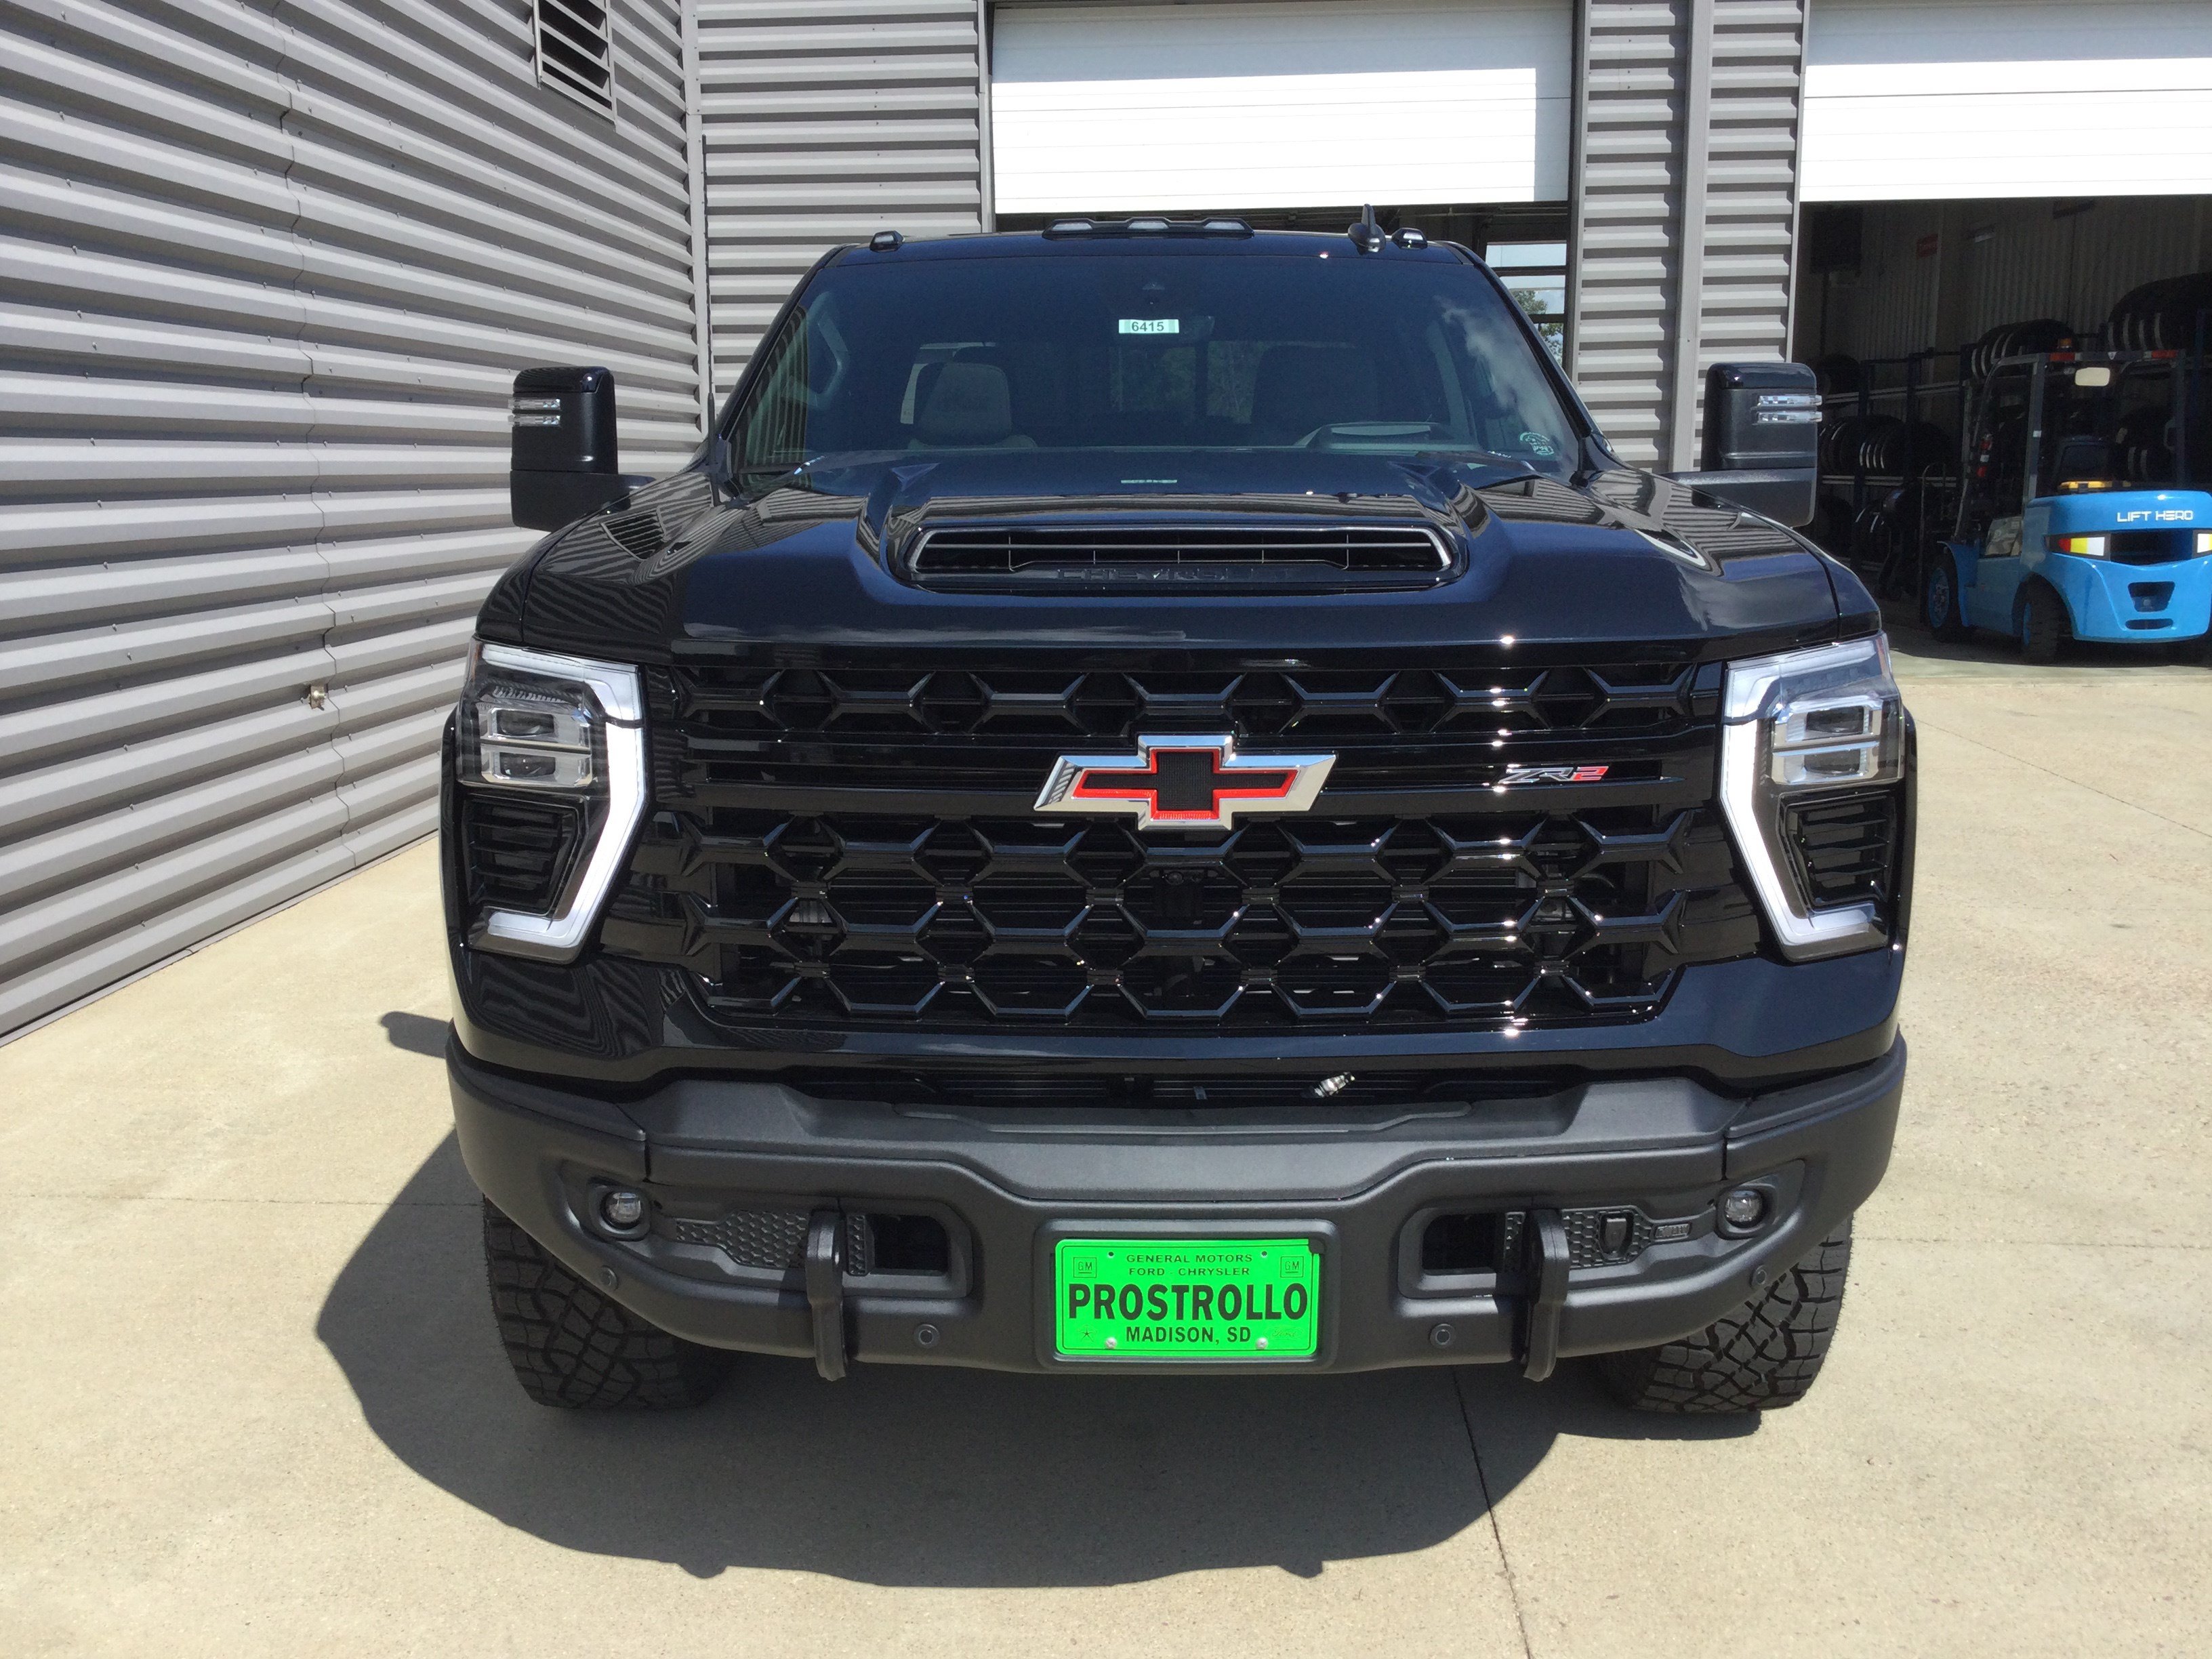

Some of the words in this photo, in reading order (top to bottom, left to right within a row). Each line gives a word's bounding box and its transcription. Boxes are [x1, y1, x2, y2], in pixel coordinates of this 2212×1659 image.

[1131, 321, 1164, 332] 6415
[2116, 511, 2152, 523] LIFT
[2155, 510, 2193, 521] HERO
[1498, 766, 1609, 784] ZR2
[1126, 1254, 1190, 1263] GENERAL
[1195, 1254, 1252, 1263] MOTORS
[1078, 1261, 1093, 1271] GM
[1129, 1268, 1165, 1276] FORD
[1178, 1267, 1250, 1276] CHRYSLER
[1285, 1261, 1300, 1271] GM
[1068, 1282, 1308, 1321] PROSTROLLO
[1126, 1326, 1220, 1345] MADISON,
[1227, 1326, 1251, 1343] SD
